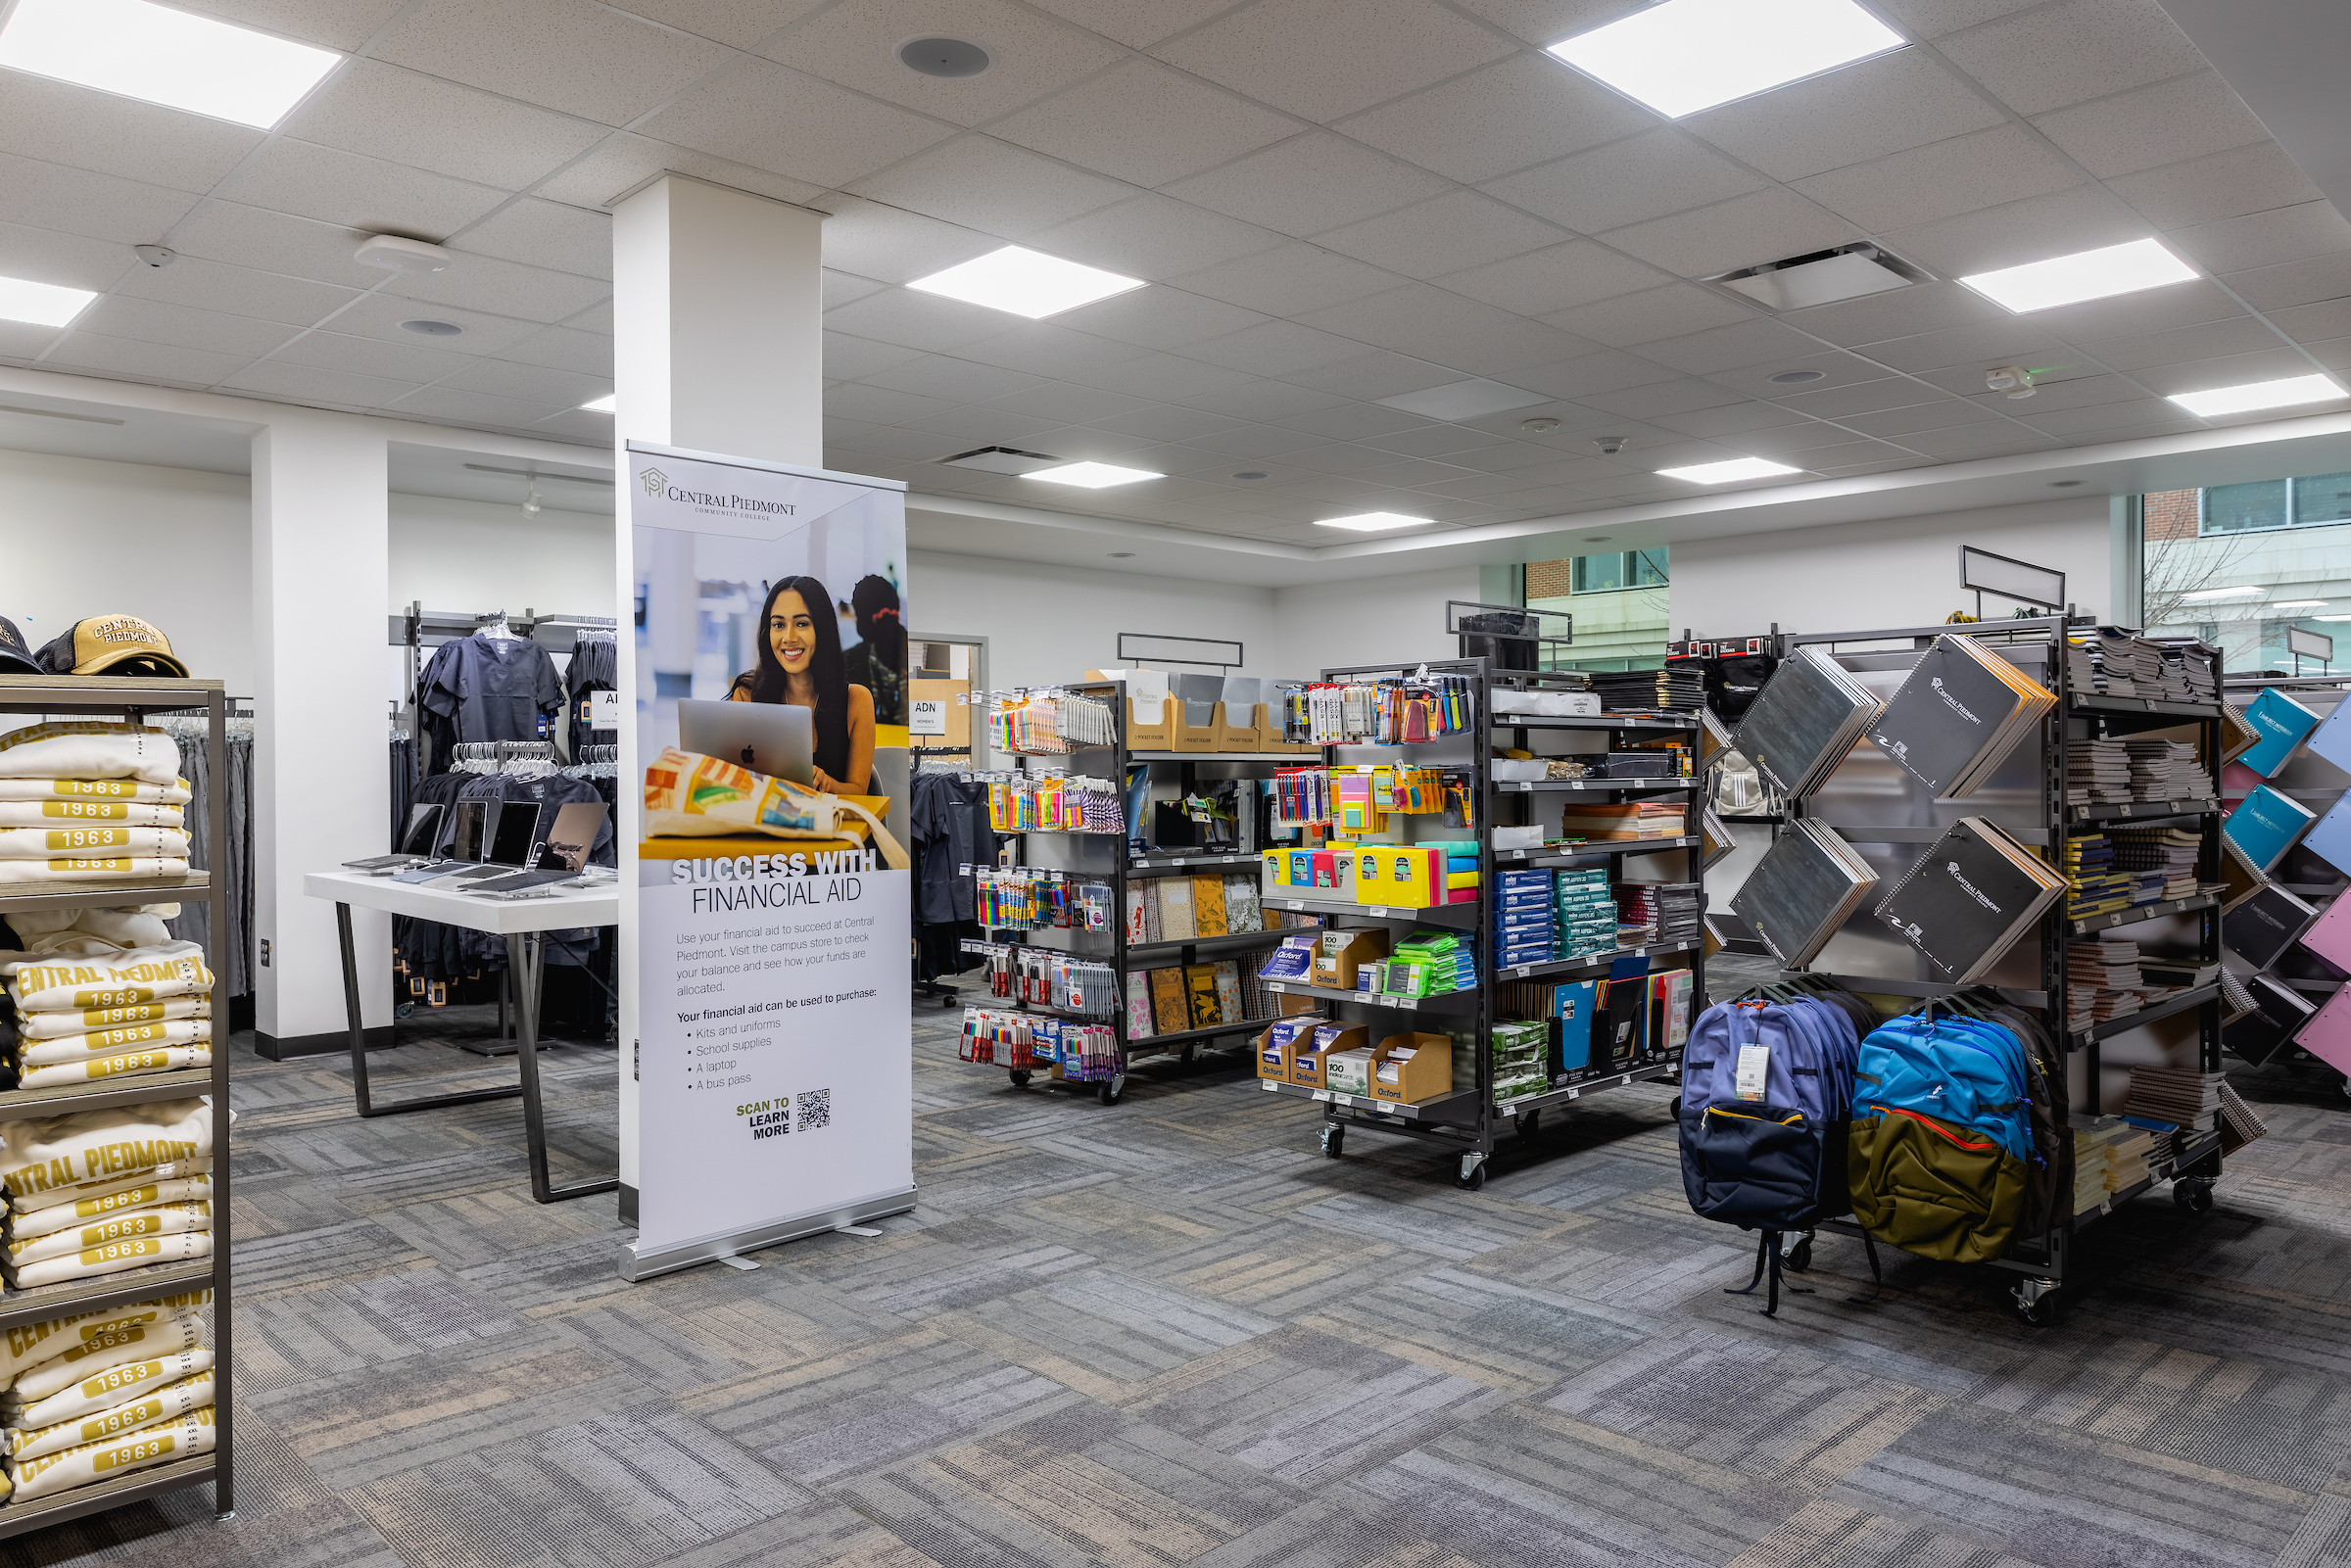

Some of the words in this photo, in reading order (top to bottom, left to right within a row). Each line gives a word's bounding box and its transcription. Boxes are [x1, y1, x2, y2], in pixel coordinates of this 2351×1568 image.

[668, 486, 730, 508] CENTRAL
[731, 495, 796, 516] PIEDMONT
[695, 506, 738, 517] COMMUNITY
[740, 512, 770, 521] COLLEGE
[915, 702, 936, 713] ADN
[1937, 687, 1959, 708] CENTRAL
[1958, 702, 1982, 725] PIEDMONT
[71, 782, 121, 795] 1963
[60, 802, 112, 818] 1963
[63, 831, 114, 846] 1963
[671, 852, 808, 884] SUCCESS
[814, 848, 877, 876] WITH
[693, 880, 820, 914] FINANCIAL
[827, 878, 862, 903] AID
[1953, 872, 1977, 895] CENTRAL
[1975, 889, 2002, 914] PIEDMONT
[676, 933, 696, 944] Use
[698, 932, 721, 944] your
[723, 927, 762, 940] financial
[765, 925, 780, 936] aid
[782, 925, 792, 934] to
[793, 920, 832, 933] succeed
[834, 920, 842, 929] at
[844, 916, 875, 928] Central
[676, 948, 727, 962] Piedmont.
[729, 944, 750, 956] Visit
[752, 943, 768, 954] the
[770, 940, 808, 955] campus
[809, 937, 833, 948] store
[835, 936, 843, 946] to
[844, 932, 869, 945] check
[1277, 951, 1303, 960] Oxford
[676, 969, 698, 981] your
[701, 964, 741, 976] balance
[743, 961, 761, 973] and
[763, 959, 782, 970] see
[784, 956, 803, 968] how
[805, 954, 824, 967] your
[826, 950, 850, 963] funds
[852, 949, 866, 959] are
[677, 981, 726, 997] allocated.
[1317, 974, 1337, 984] Oxford
[91, 990, 138, 1007] 1963
[677, 1012, 700, 1022] Your
[702, 1005, 745, 1021] financial
[747, 1003, 763, 1014] aid
[765, 1001, 783, 1012] can
[786, 997, 798, 1009] be
[800, 994, 823, 1007] used
[825, 993, 834, 1003] to
[836, 987, 877, 1003] purchase:
[100, 1006, 150, 1022] 1963
[101, 1025, 151, 1045] 1963
[696, 1027, 716, 1039] Kits
[718, 1023, 738, 1036] and
[740, 1018, 782, 1033] uniforms
[696, 1042, 730, 1056] School
[732, 1036, 772, 1053] supplies
[103, 1054, 153, 1074] 1963
[696, 1063, 703, 1073] A
[706, 1058, 737, 1073] laptop
[1263, 1066, 1283, 1076] Oxford
[1328, 1064, 1344, 1072] 100
[696, 1080, 703, 1091] A
[706, 1077, 725, 1089] bus
[728, 1073, 751, 1087] pass
[1296, 1072, 1319, 1082] Oxford
[1377, 1087, 1402, 1099] Oxford
[736, 1100, 770, 1117] SCAN
[773, 1097, 790, 1109] TO
[749, 1110, 790, 1127] LEARN
[753, 1123, 790, 1140] MORE
[84, 1139, 198, 1178] PIEDMONT
[92, 1189, 142, 1212] 1963
[97, 1219, 146, 1241] 1963
[96, 1241, 146, 1260] 1963
[79, 1332, 129, 1354] 1963
[97, 1365, 148, 1391] 1963
[97, 1406, 148, 1435] 1963
[109, 1442, 160, 1466] 1963
